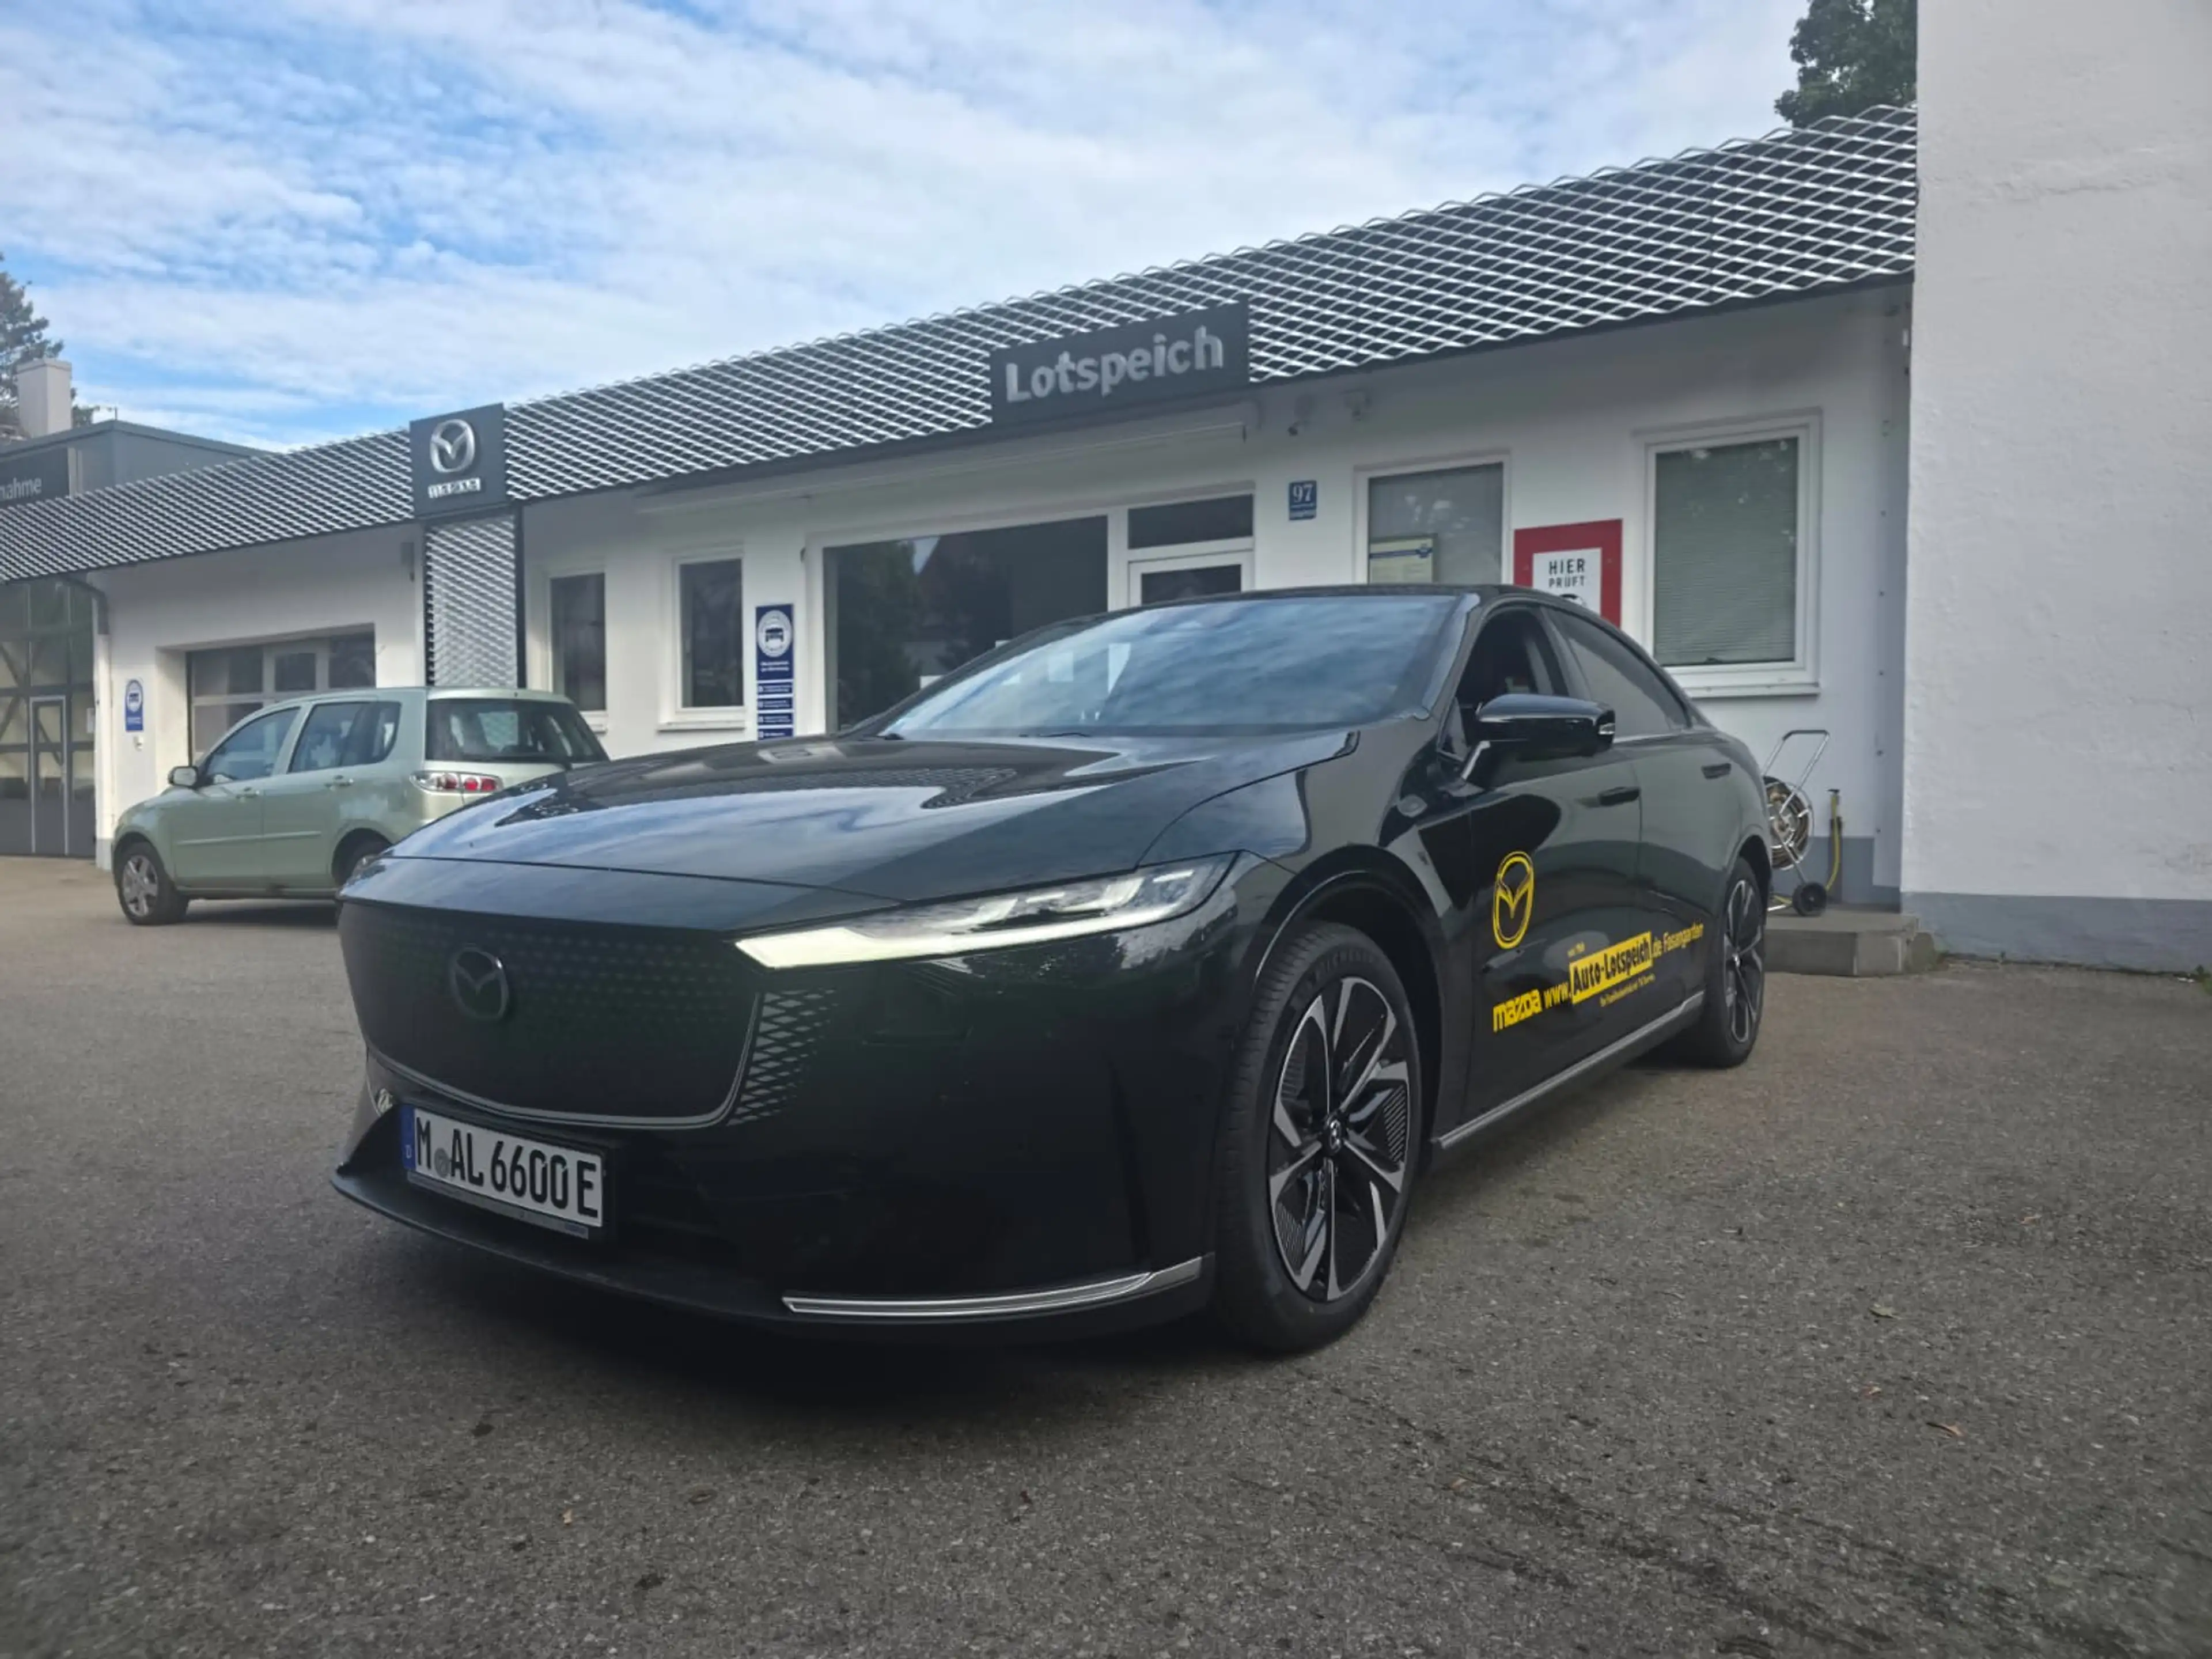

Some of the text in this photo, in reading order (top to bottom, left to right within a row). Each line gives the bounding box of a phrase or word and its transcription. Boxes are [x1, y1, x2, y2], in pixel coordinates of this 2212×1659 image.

[1005, 325, 1224, 403] Lotspeich
[1293, 484, 1313, 503] 97
[1548, 558, 1585, 575] HIER
[1493, 988, 1543, 1033] mazda
[416, 1116, 431, 1171] M
[450, 1128, 484, 1188] AL
